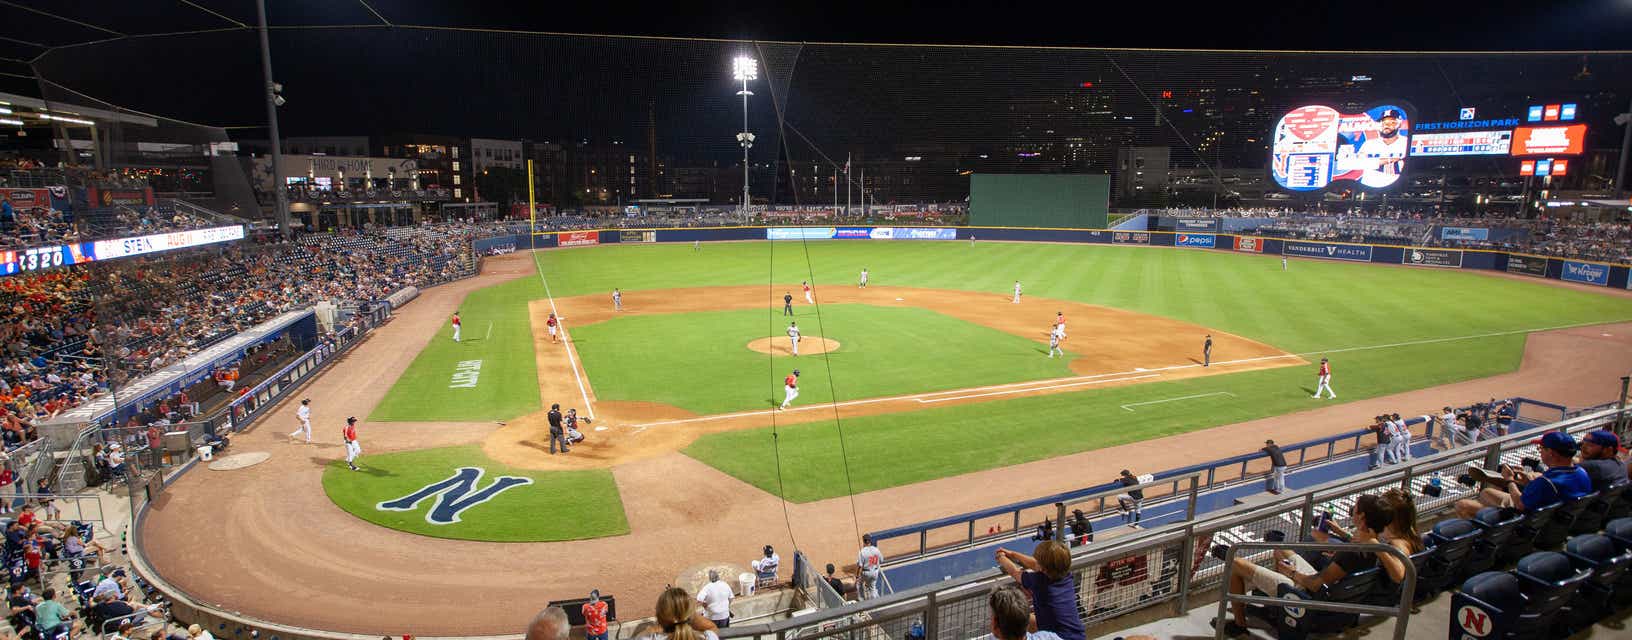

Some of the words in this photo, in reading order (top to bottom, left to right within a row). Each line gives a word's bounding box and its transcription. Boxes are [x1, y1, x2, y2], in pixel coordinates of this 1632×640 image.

[1415, 122, 1441, 130] FIRST
[1443, 120, 1489, 129] HORIZON
[1491, 118, 1520, 127] PARK
[168, 234, 185, 247] AUG
[1189, 237, 1212, 245] pepsi
[1288, 245, 1325, 253] VANDERBILT
[41, 253, 51, 268] 2
[53, 252, 63, 266] 0
[1577, 264, 1603, 282] Kroger
[376, 467, 535, 525] N
[1463, 607, 1487, 634] N
